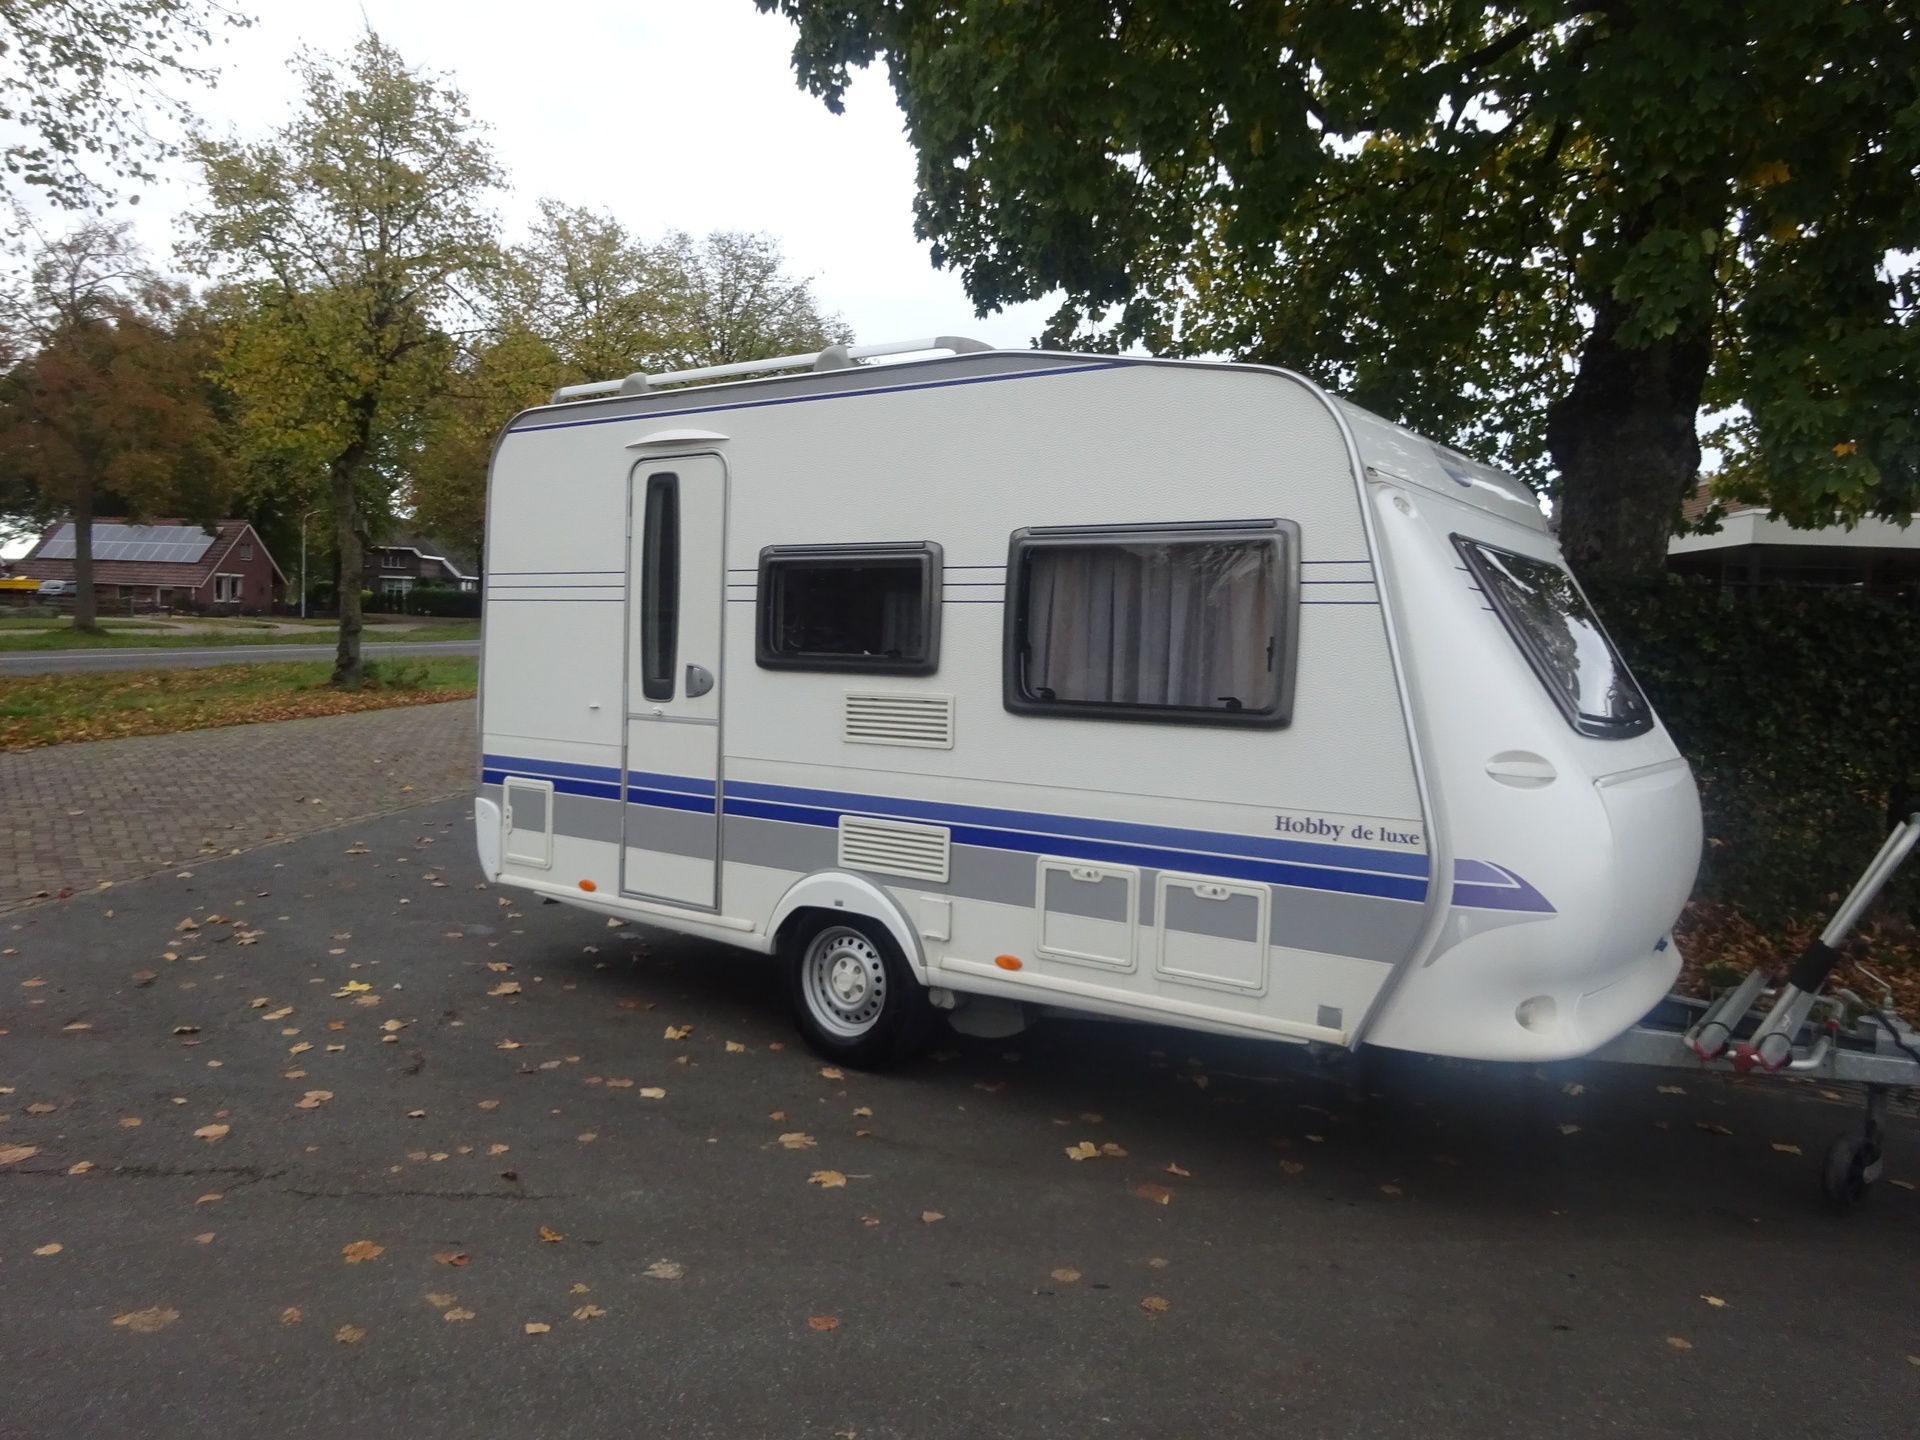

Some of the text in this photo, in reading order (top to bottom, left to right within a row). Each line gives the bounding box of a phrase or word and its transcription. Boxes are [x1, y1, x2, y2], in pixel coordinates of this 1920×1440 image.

[1275, 815, 1420, 845] Hobby de luxe
